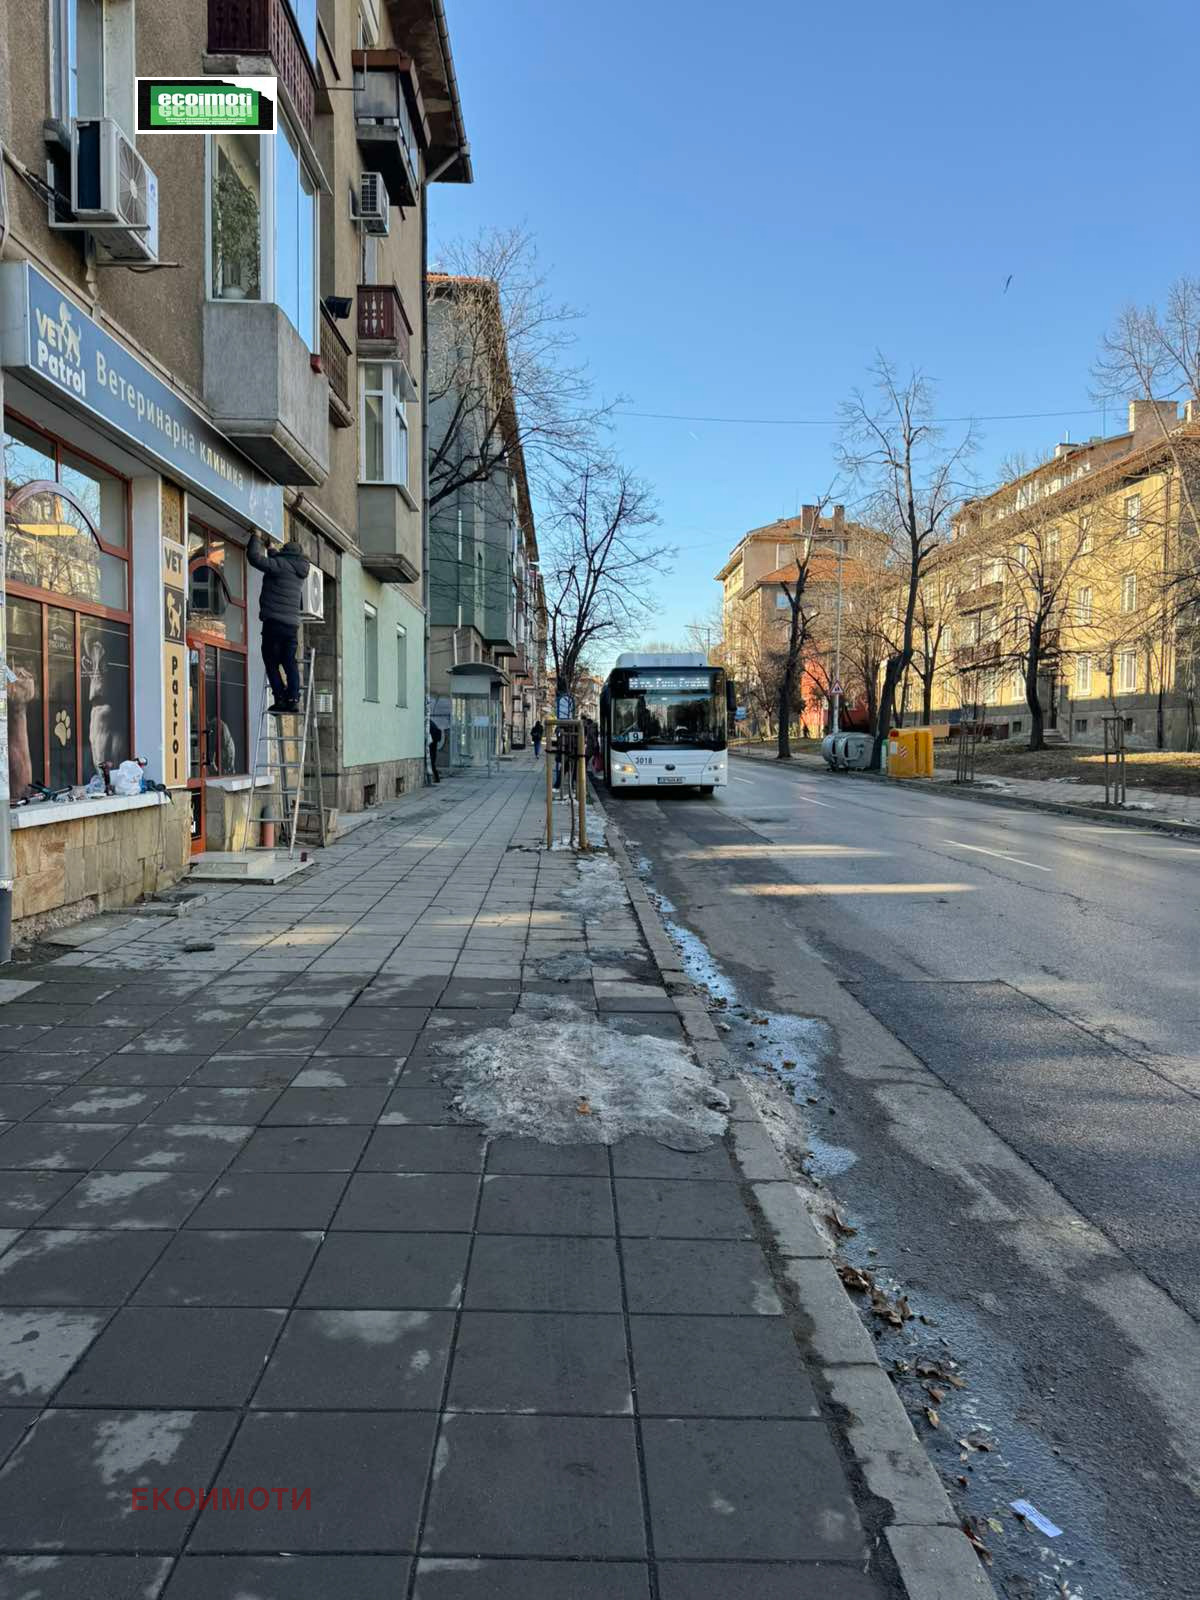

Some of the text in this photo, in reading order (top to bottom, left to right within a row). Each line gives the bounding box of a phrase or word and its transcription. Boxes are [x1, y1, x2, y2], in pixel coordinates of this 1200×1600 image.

[36, 307, 63, 353] VET
[37, 339, 86, 397] Patrol
[96, 351, 244, 492] Ветеринарна клиника
[164, 545, 183, 575] VET
[632, 733, 639, 741] 9
